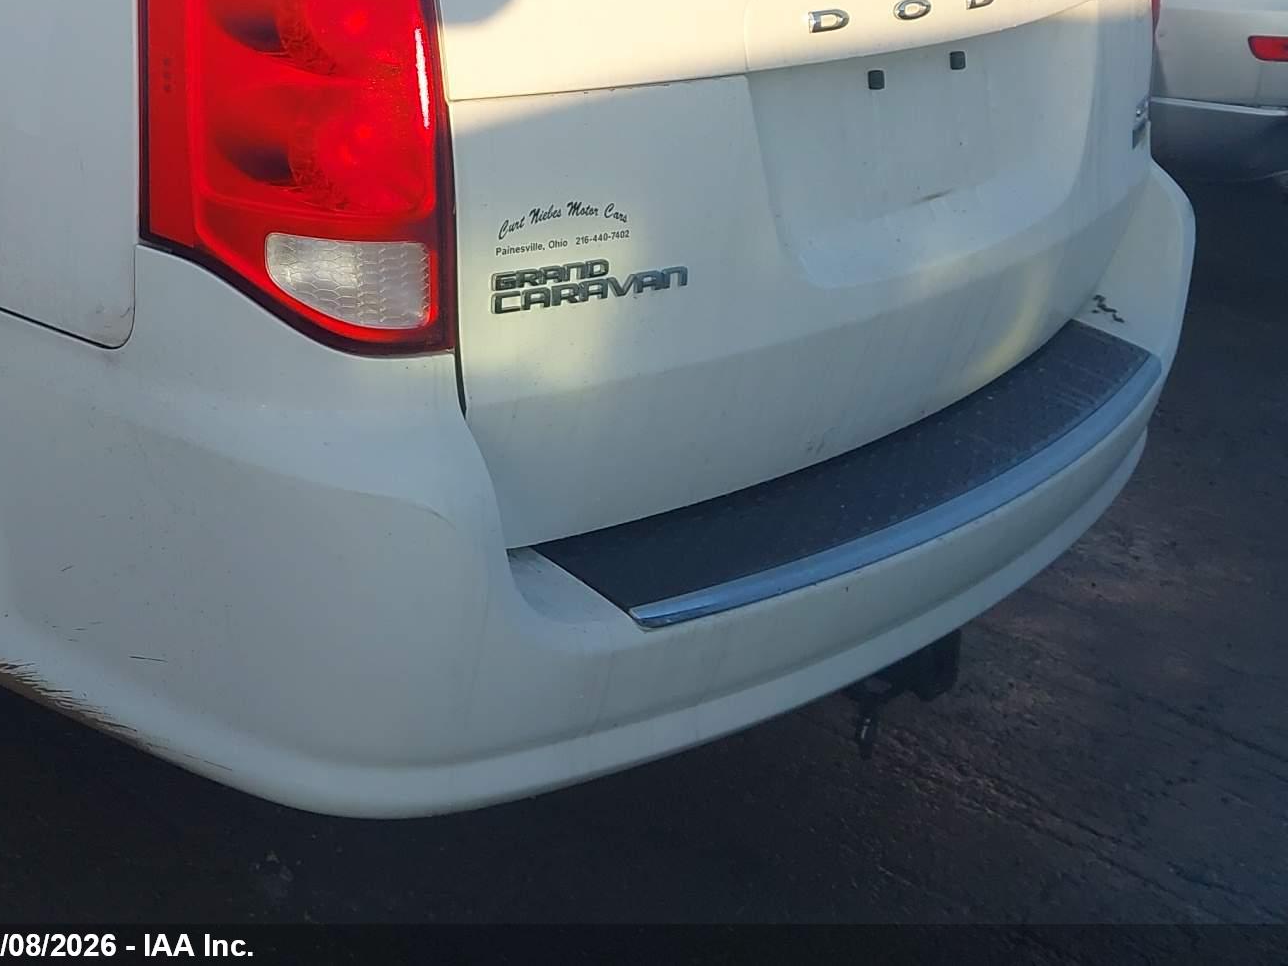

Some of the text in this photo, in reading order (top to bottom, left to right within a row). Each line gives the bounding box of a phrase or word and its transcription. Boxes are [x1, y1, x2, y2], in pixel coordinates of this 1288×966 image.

[497, 200, 630, 241] Curt Niebes Motor Cars
[495, 229, 630, 257] Painesville, Ohio 216-440-7402
[491, 258, 610, 292] GRAND
[491, 265, 689, 315] CARAVAN
